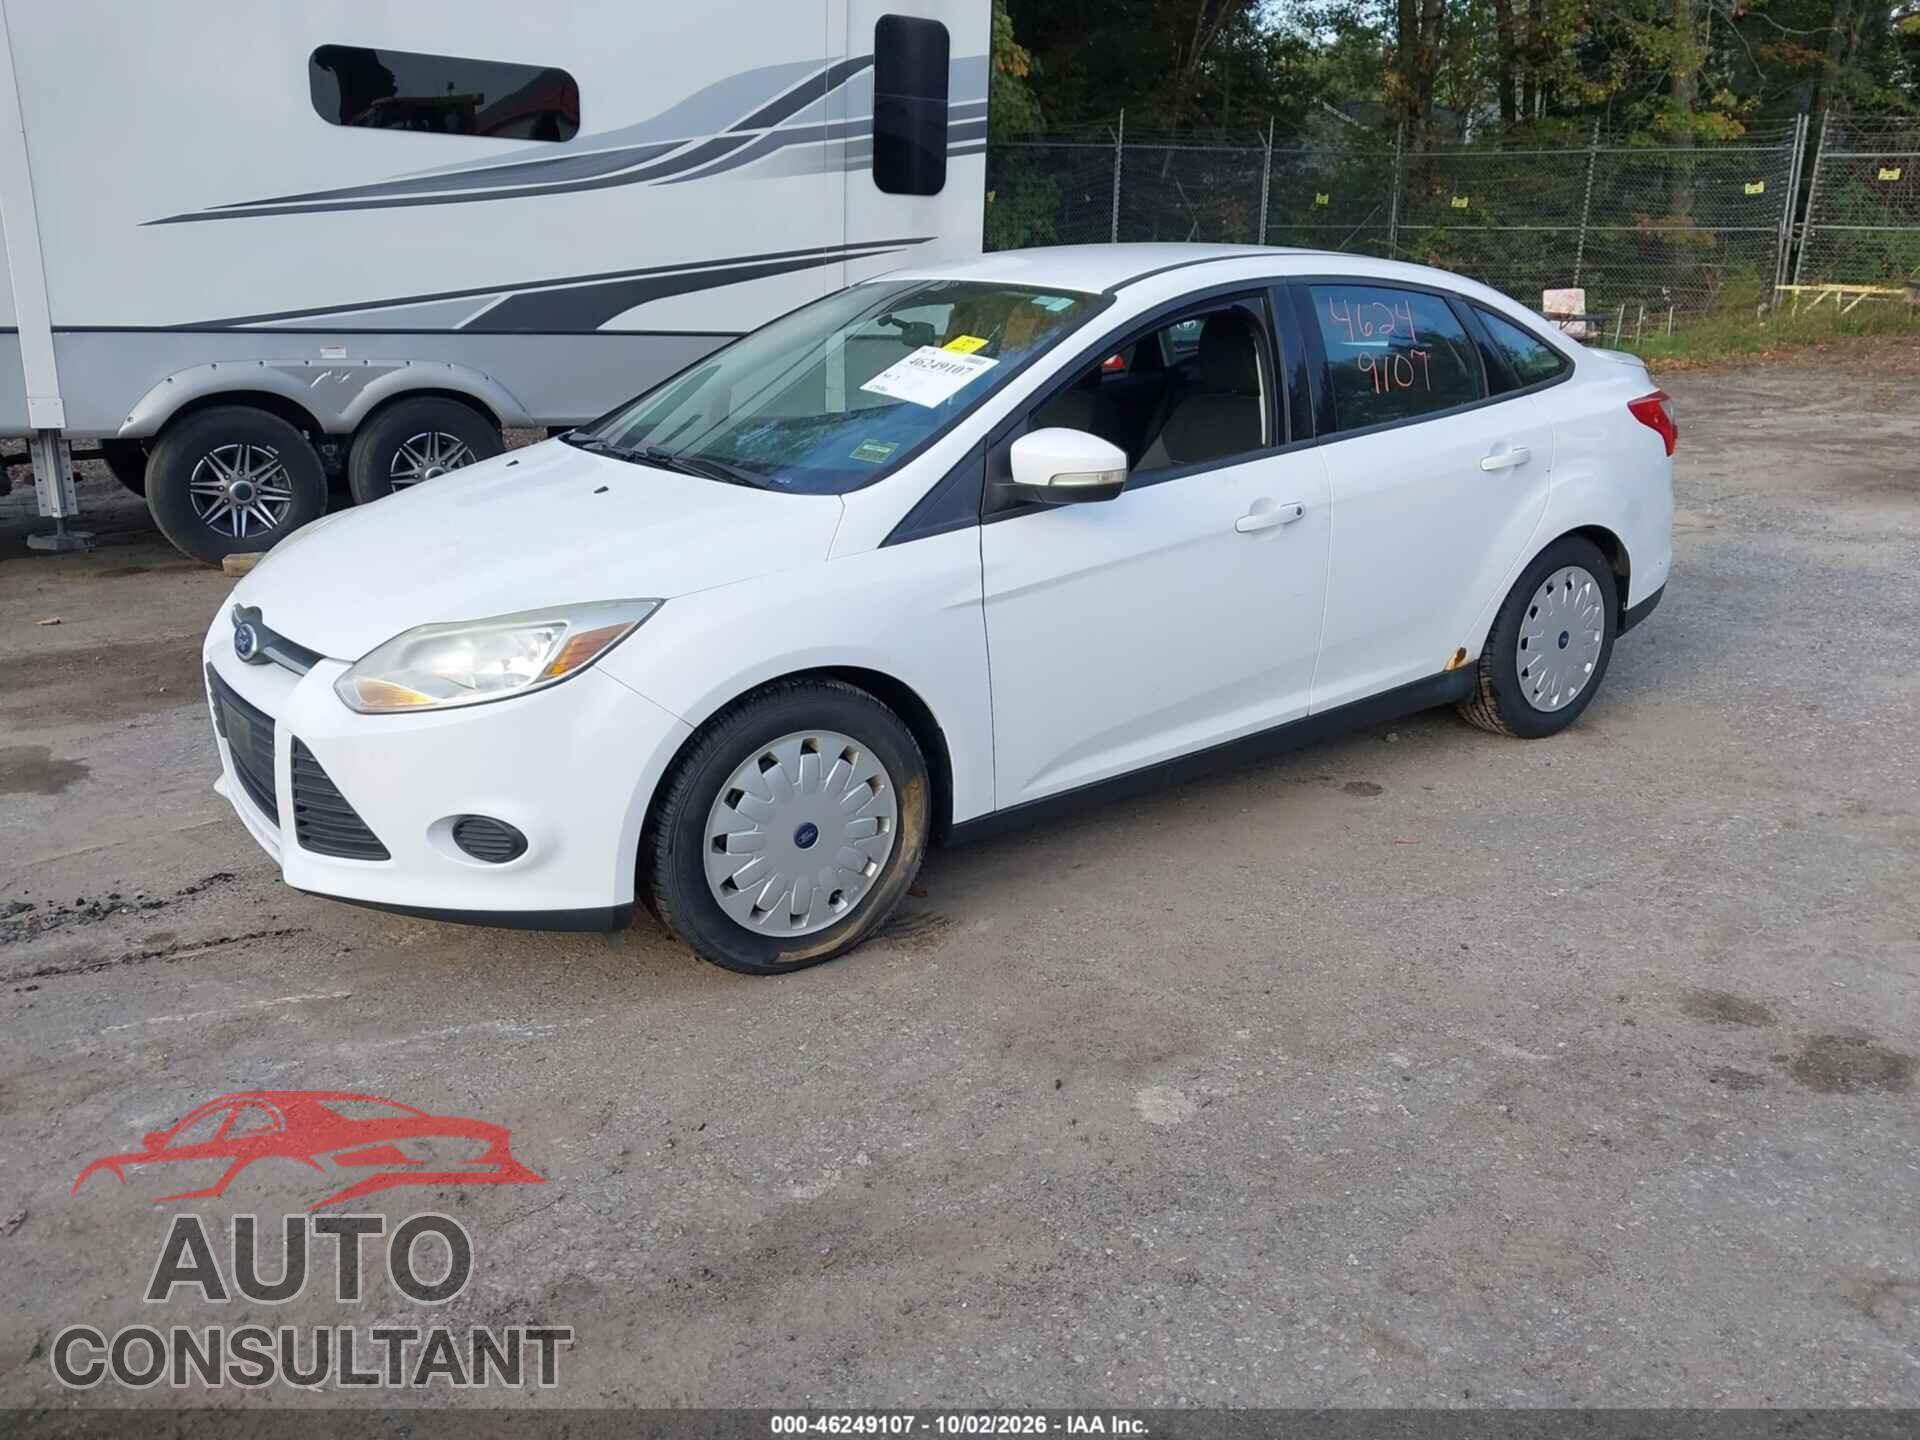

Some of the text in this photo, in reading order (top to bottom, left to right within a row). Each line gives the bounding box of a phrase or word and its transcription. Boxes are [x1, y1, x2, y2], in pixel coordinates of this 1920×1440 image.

[1328, 296, 1417, 344] 4624
[908, 357, 974, 376] 46249107
[1358, 348, 1431, 395] 9107
